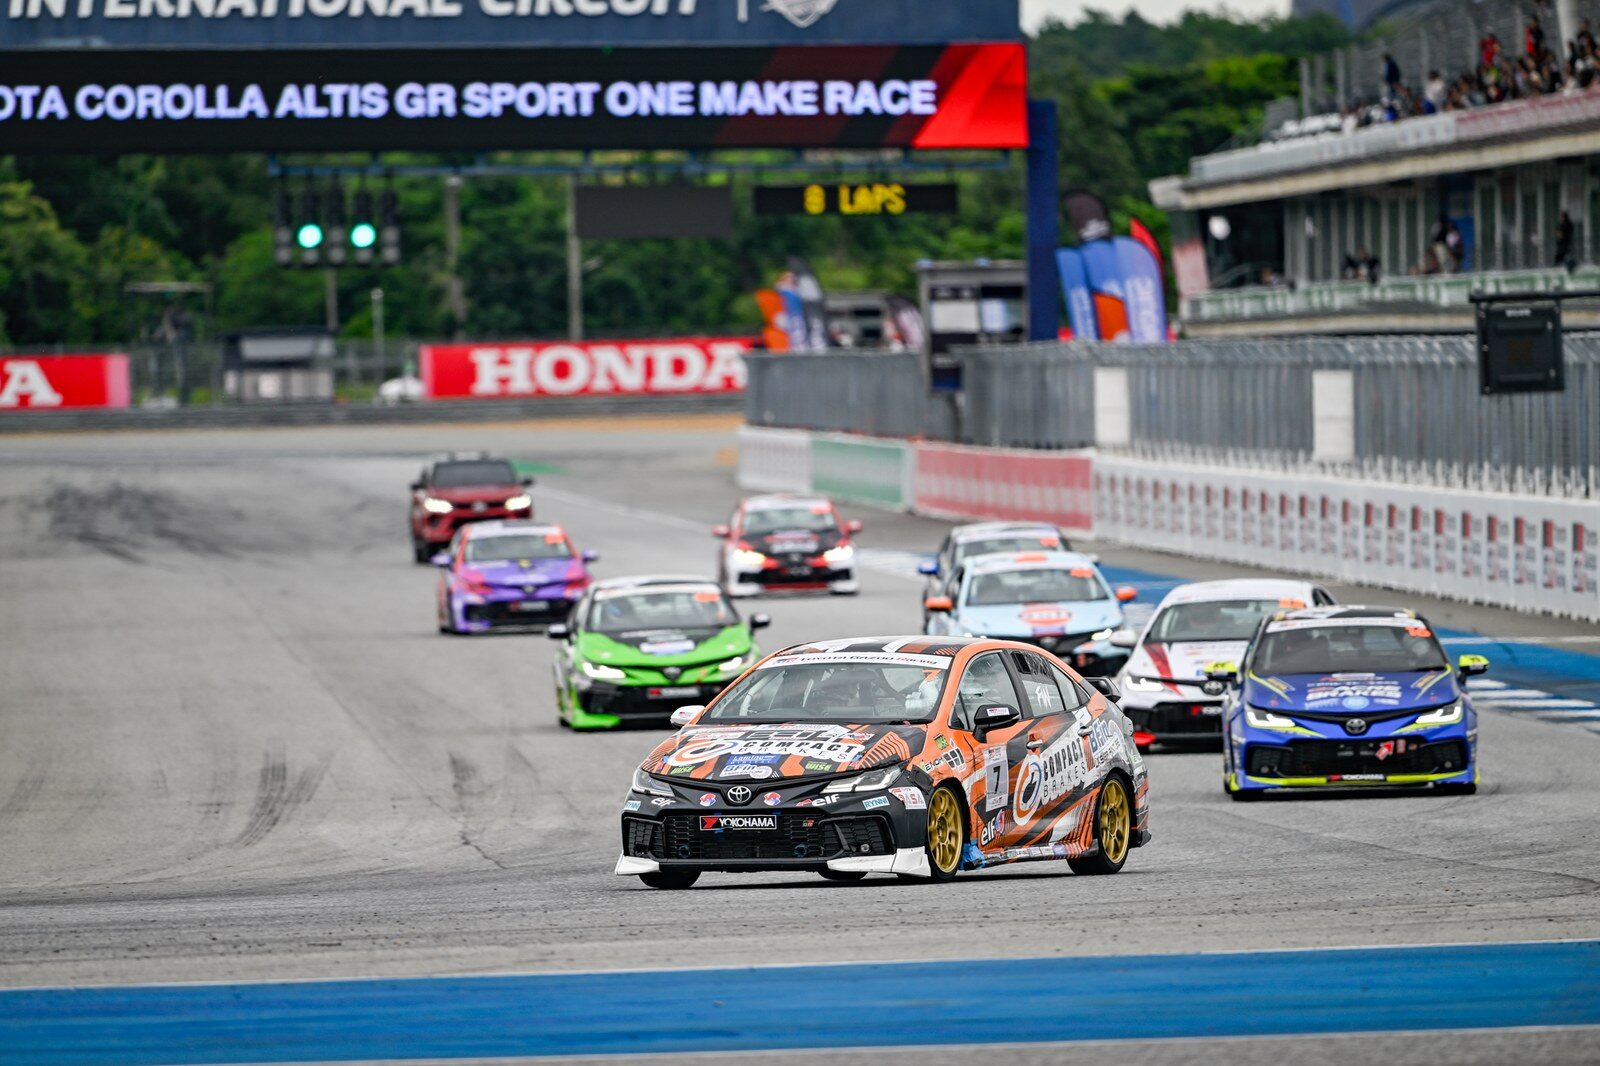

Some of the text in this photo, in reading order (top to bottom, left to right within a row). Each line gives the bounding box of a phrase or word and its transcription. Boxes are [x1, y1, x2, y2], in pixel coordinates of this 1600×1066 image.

[75, 83, 270, 120] COROLLA
[274, 82, 389, 119] ALTIS
[394, 82, 458, 119] GR
[462, 81, 600, 118] SPORT
[604, 81, 696, 118] ONE
[700, 81, 819, 116] MAKE
[823, 80, 937, 115] RACE
[839, 183, 907, 216] LAPS
[470, 342, 748, 396] HONDA
[895, 657, 939, 665] Racing
[737, 747, 848, 760] BRAKES
[742, 741, 858, 753] COMPACT
[1043, 737, 1084, 782] COMPACT
[993, 765, 1001, 794] 7
[1043, 761, 1087, 798] BRAKES
[650, 797, 676, 808] elf
[811, 793, 840, 807] elf
[719, 817, 775, 828] YOKOHAMA
[981, 817, 996, 846] elf
